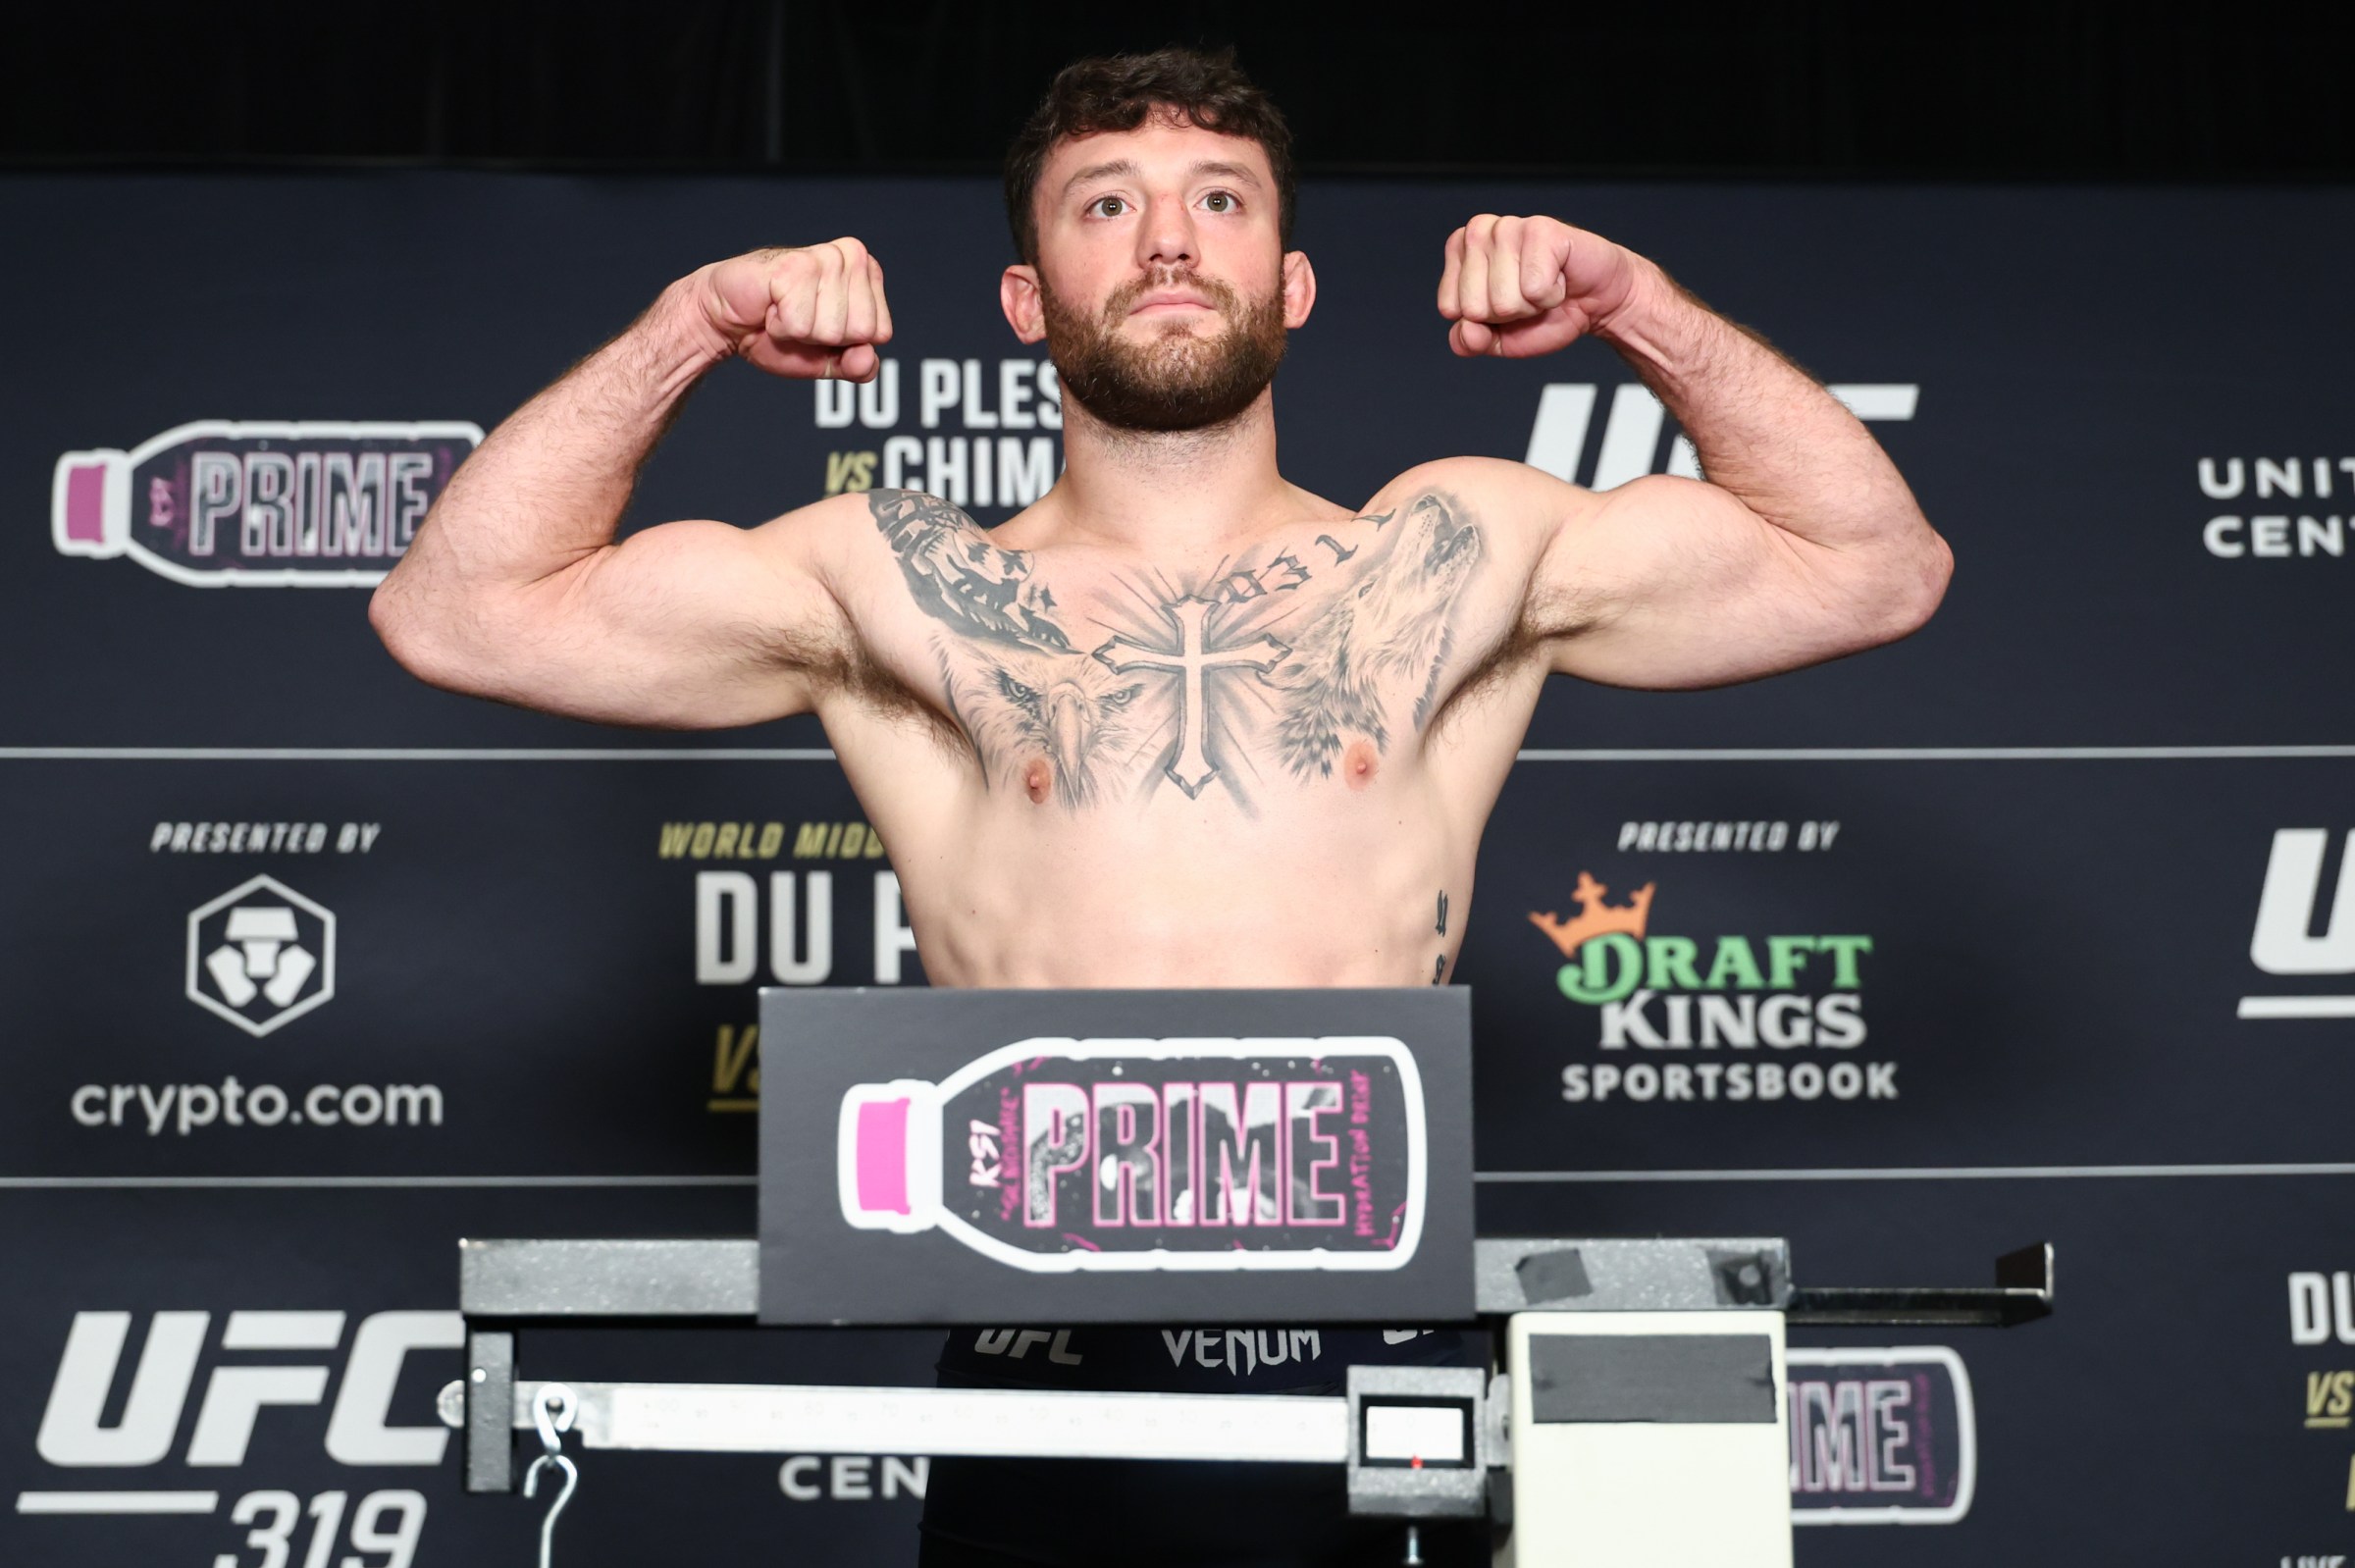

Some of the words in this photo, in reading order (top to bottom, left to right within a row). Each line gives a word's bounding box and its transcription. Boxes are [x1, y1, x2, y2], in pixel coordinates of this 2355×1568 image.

[814, 359, 899, 429] DU
[824, 450, 878, 494] VS
[189, 451, 433, 557] PRIME
[2202, 515, 2355, 558] CEN
[150, 822, 328, 854] PRESENTED
[336, 822, 381, 854] BY
[658, 822, 784, 859] WORLD
[1617, 820, 1789, 852] PRESENTED
[1797, 820, 1841, 852] BY
[696, 870, 832, 984] DU
[1556, 932, 1873, 1005] DRAFT
[1599, 989, 1866, 1050] KINGS
[71, 1076, 445, 1136] crypto.com
[1561, 1063, 1899, 1102] SPORTSBOOK
[1023, 1082, 1345, 1228] PRIME
[1161, 1329, 1322, 1376] VENUM
[36, 1310, 466, 1466] UFC
[2306, 1371, 2355, 1416] VS
[778, 1455, 930, 1500] CEN
[212, 1490, 428, 1568] 319
